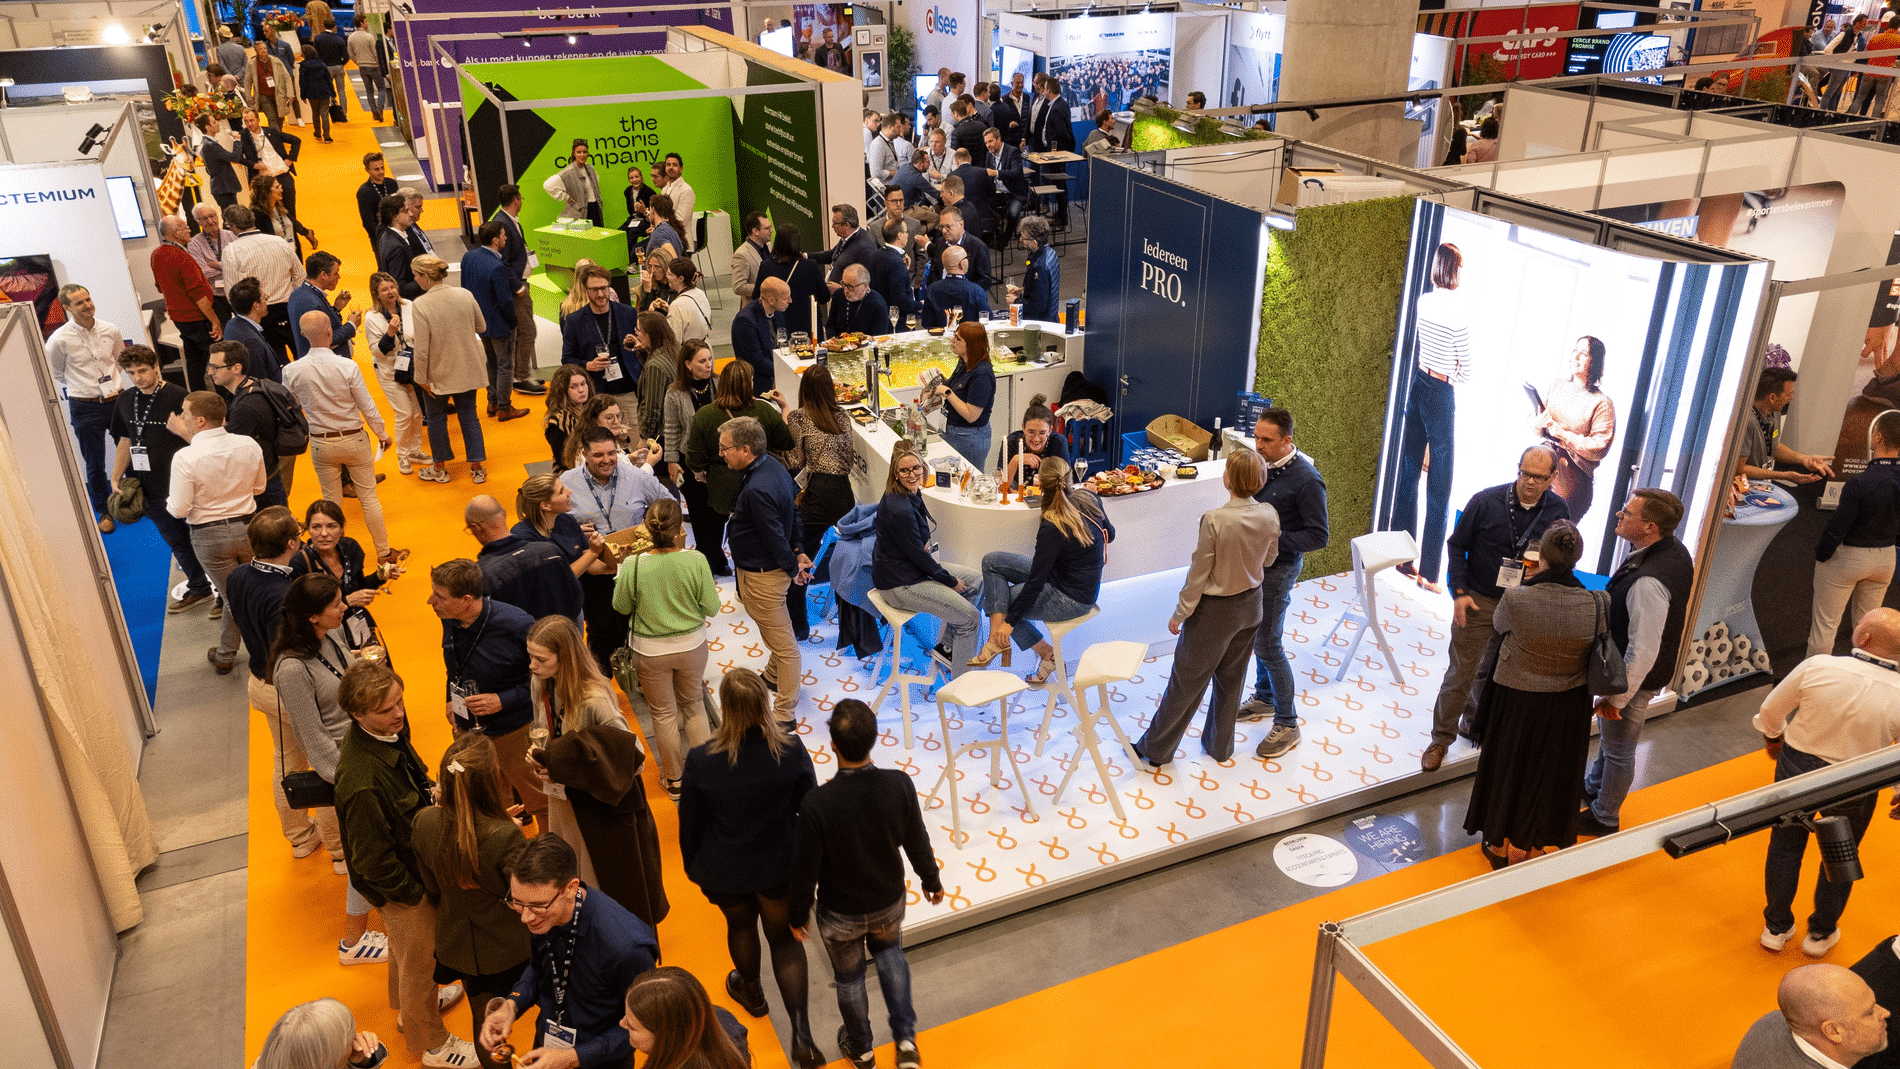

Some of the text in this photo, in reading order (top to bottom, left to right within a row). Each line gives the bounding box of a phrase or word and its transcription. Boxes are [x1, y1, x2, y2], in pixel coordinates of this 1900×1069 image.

[1502, 26, 1559, 50] CAPS
[1509, 53, 1531, 61] ENRGY
[619, 115, 658, 132] the
[594, 133, 659, 150] moris
[1746, 199, 1834, 219] #sportersbelevenmeer
[1143, 237, 1188, 271] Iedereen
[1140, 260, 1186, 308] PRO.
[1356, 824, 1402, 843] WE ARE
[1367, 833, 1407, 850] HIRING
